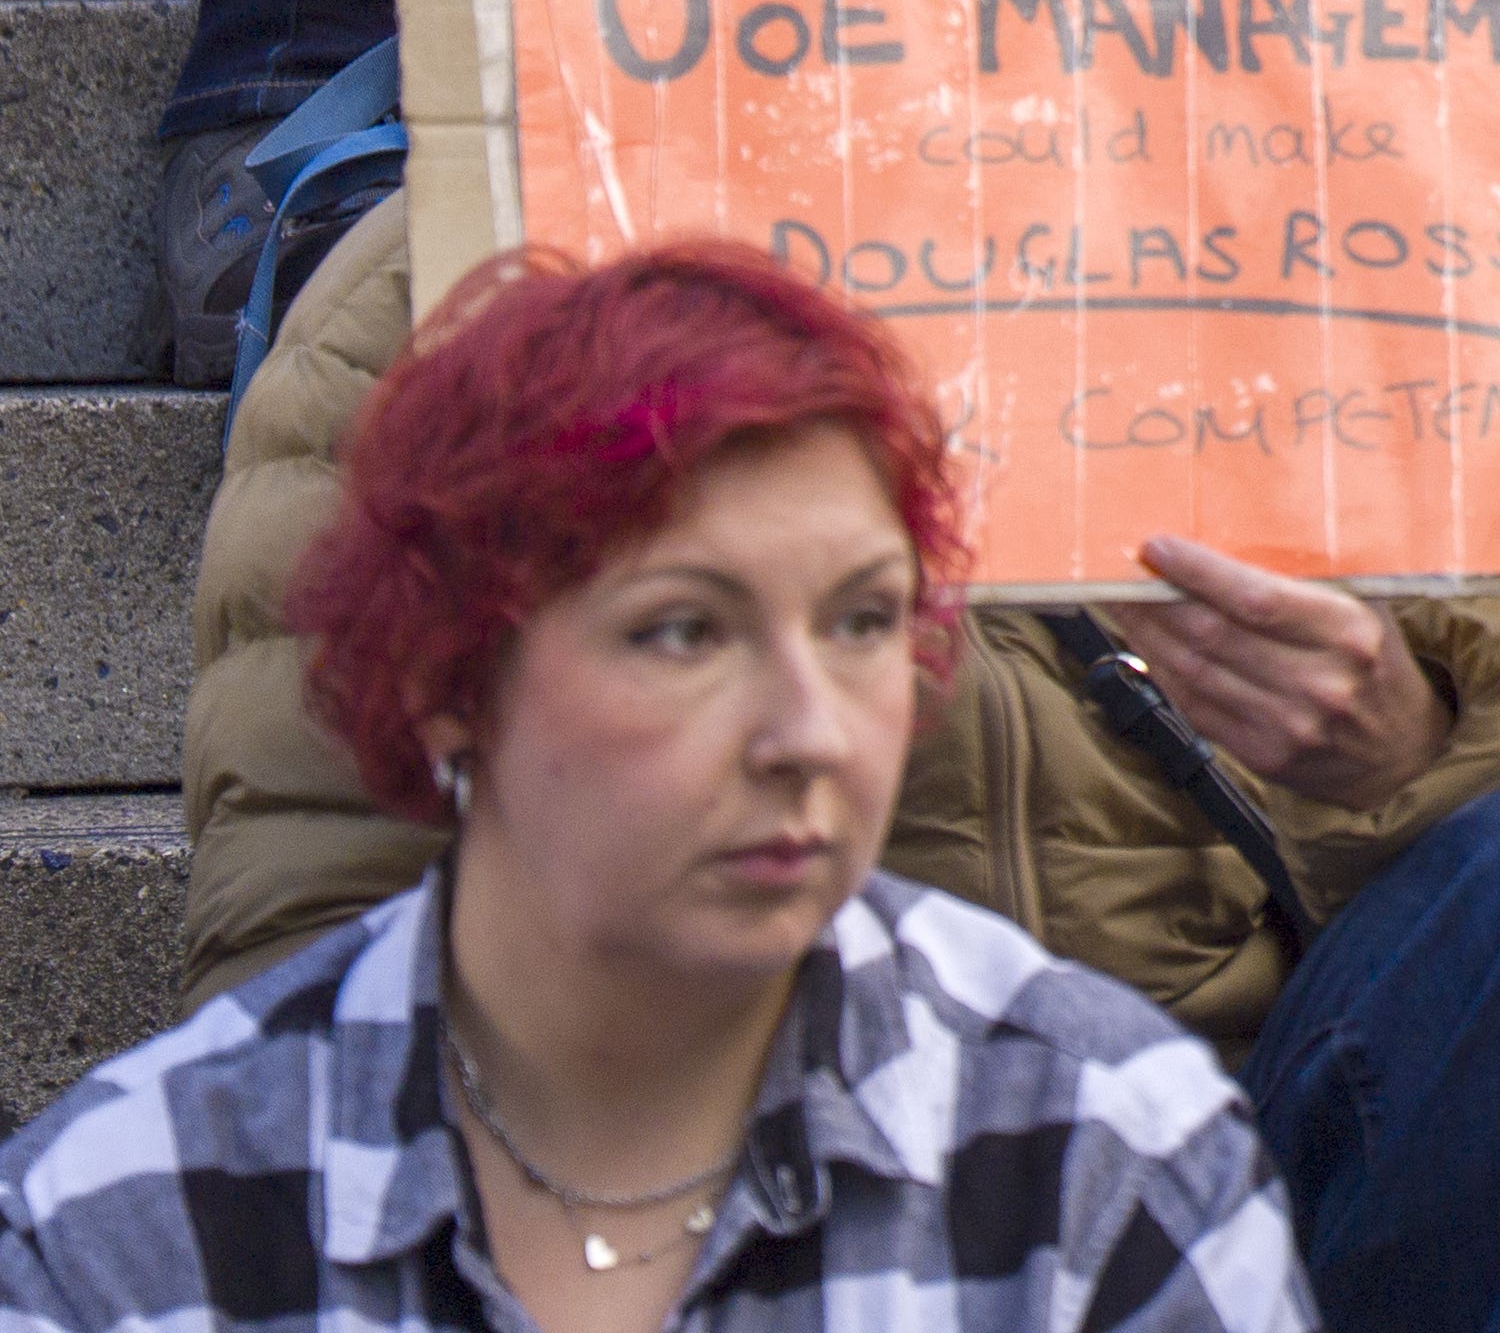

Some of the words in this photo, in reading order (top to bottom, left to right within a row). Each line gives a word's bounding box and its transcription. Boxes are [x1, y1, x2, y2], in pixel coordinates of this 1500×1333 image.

[918, 111, 1149, 168] could
[1210, 109, 1407, 164] make
[773, 219, 1241, 293] DOUGLAS
